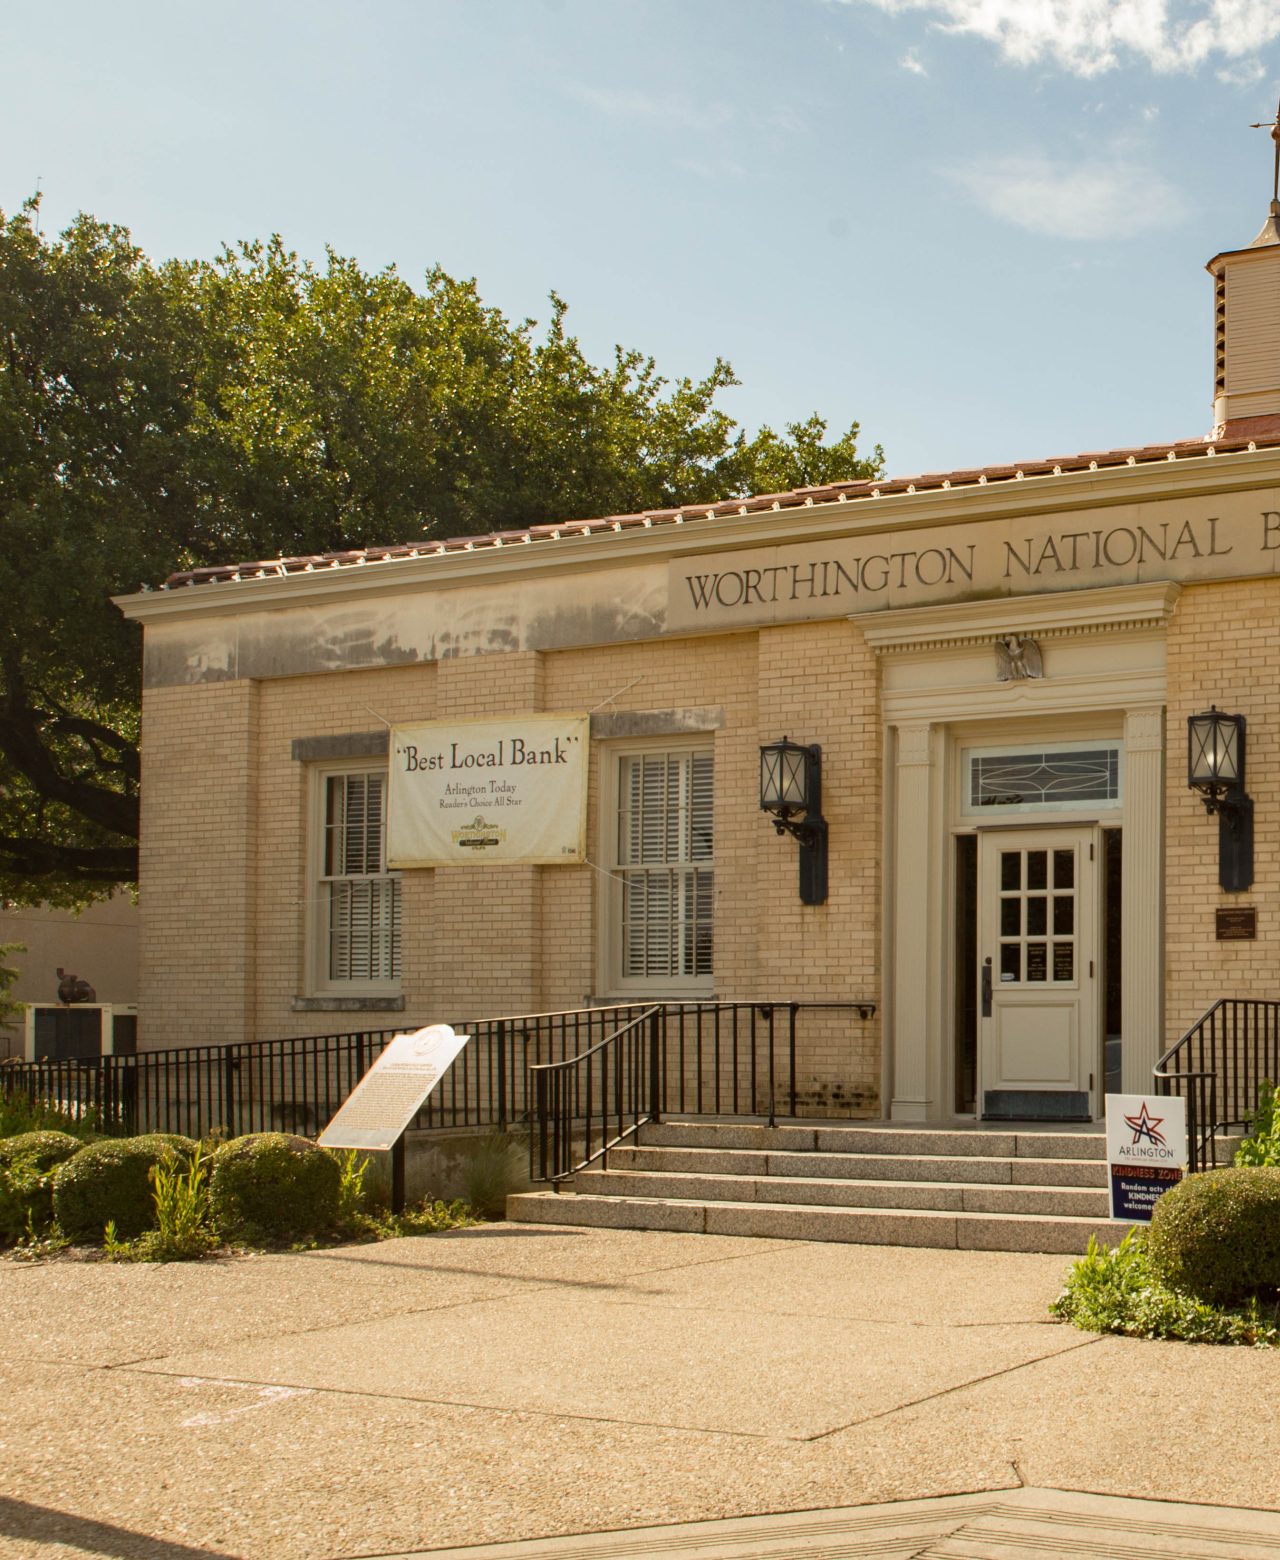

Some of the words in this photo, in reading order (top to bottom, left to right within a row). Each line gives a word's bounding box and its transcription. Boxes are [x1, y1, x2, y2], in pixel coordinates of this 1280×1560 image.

[685, 545, 976, 610] WORTHINGTON
[1003, 517, 1233, 577] NATIONAL
[450, 741, 504, 769] Local
[444, 781, 487, 796] Arlington
[488, 780, 517, 794] Today
[469, 797, 494, 807] Choice
[494, 796, 505, 806] All
[506, 795, 522, 806] Star
[1118, 1146, 1174, 1158] ARLINGTON
[1112, 1165, 1155, 1179] KINDNESS
[1157, 1169, 1183, 1181] ZONE
[1121, 1182, 1147, 1192] Random
[1149, 1185, 1163, 1193] acts
[1128, 1192, 1160, 1201] KINDNES
